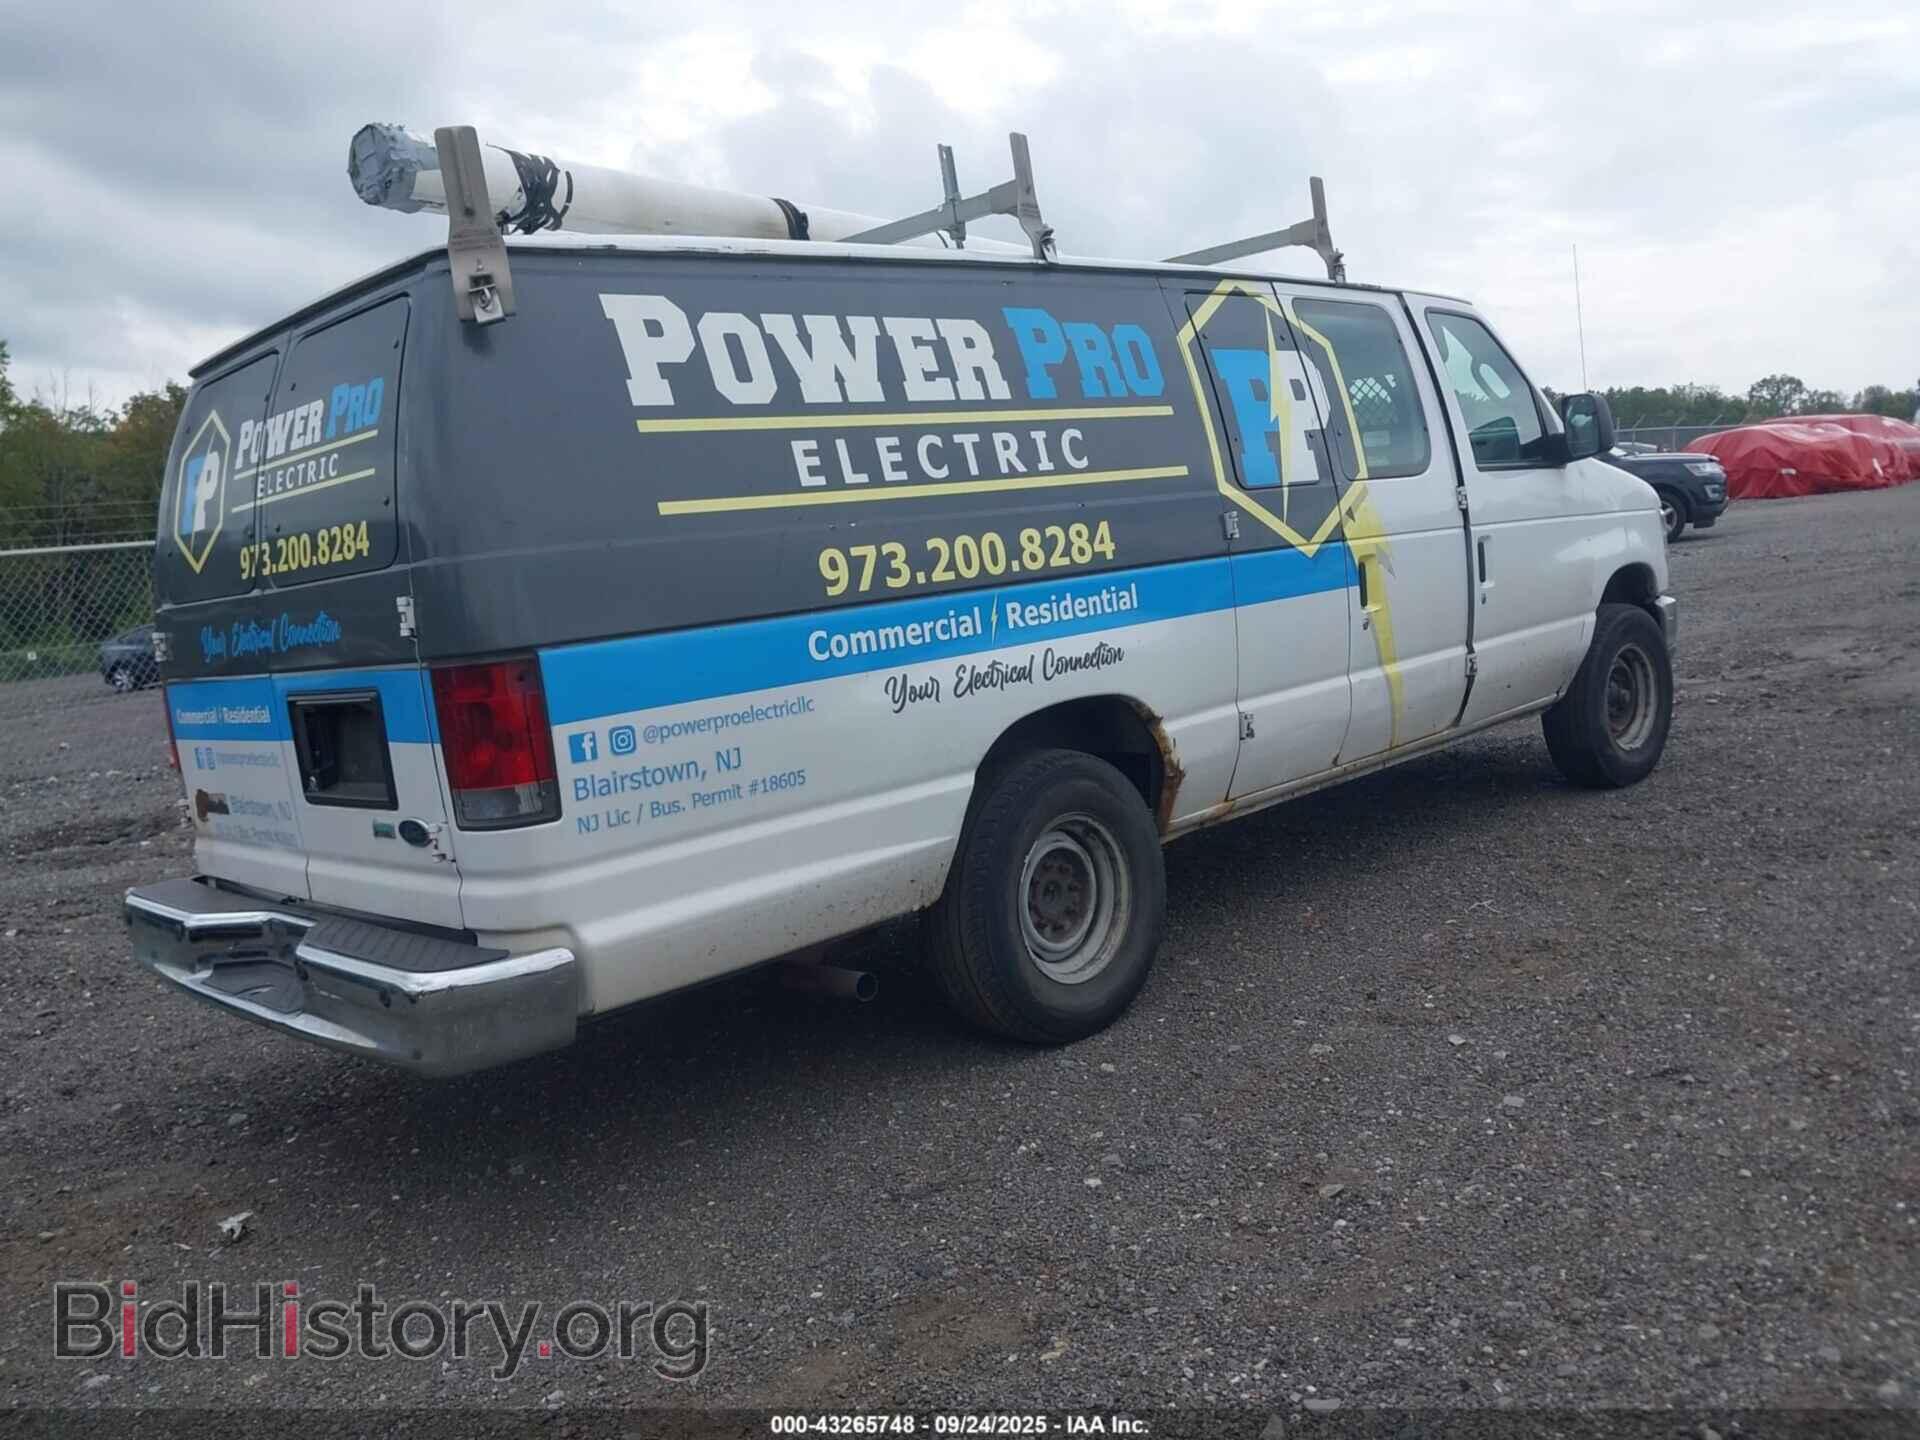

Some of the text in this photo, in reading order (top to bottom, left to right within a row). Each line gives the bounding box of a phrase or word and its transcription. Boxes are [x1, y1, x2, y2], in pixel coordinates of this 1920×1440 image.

[599, 293, 1164, 406] POWER PRO
[234, 376, 384, 470] POWER PRO
[256, 453, 340, 497] ELECTRIC
[790, 428, 1089, 486] ELECTRIC
[239, 520, 370, 580] 973.200.8284
[818, 520, 1116, 597] 973.200.8284
[807, 583, 1139, 662] Commercial Residential
[884, 640, 1126, 714] Your Electrical Connection
[643, 696, 815, 745] @powerproelectricllc
[573, 747, 742, 801] Blairstown, NJ
[577, 814, 599, 835] NJ
[607, 809, 631, 829] Lic
[651, 799, 686, 818] Bus.
[692, 784, 742, 810] Permit
[748, 769, 806, 794] #18605
